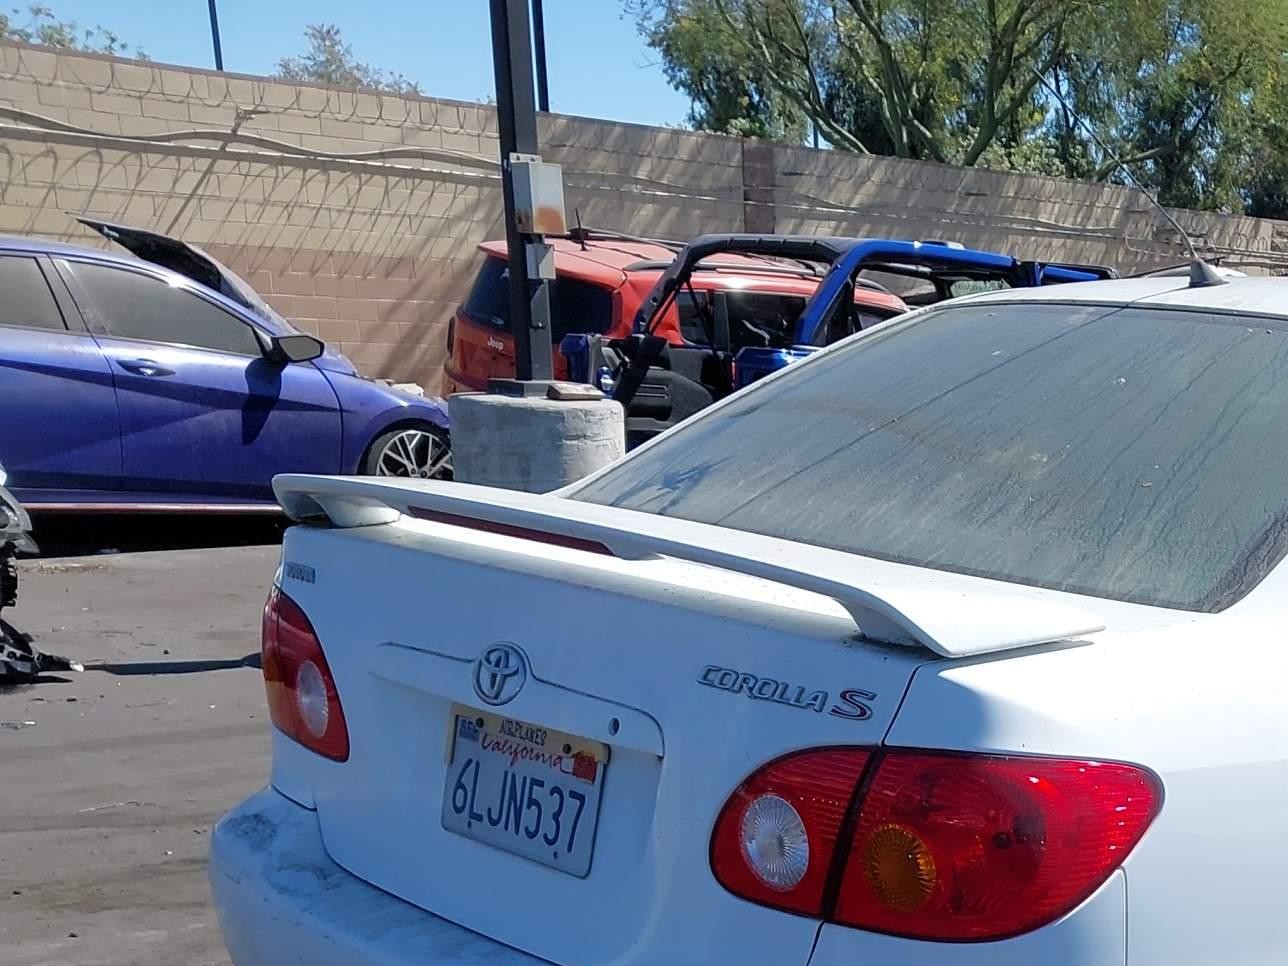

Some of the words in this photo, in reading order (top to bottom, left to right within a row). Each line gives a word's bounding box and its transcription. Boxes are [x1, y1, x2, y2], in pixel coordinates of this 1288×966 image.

[487, 336, 504, 351] Jeep
[697, 664, 829, 713] COROLLA
[828, 688, 877, 721] S
[481, 732, 564, 768] California
[452, 758, 586, 854] 6LJN537
